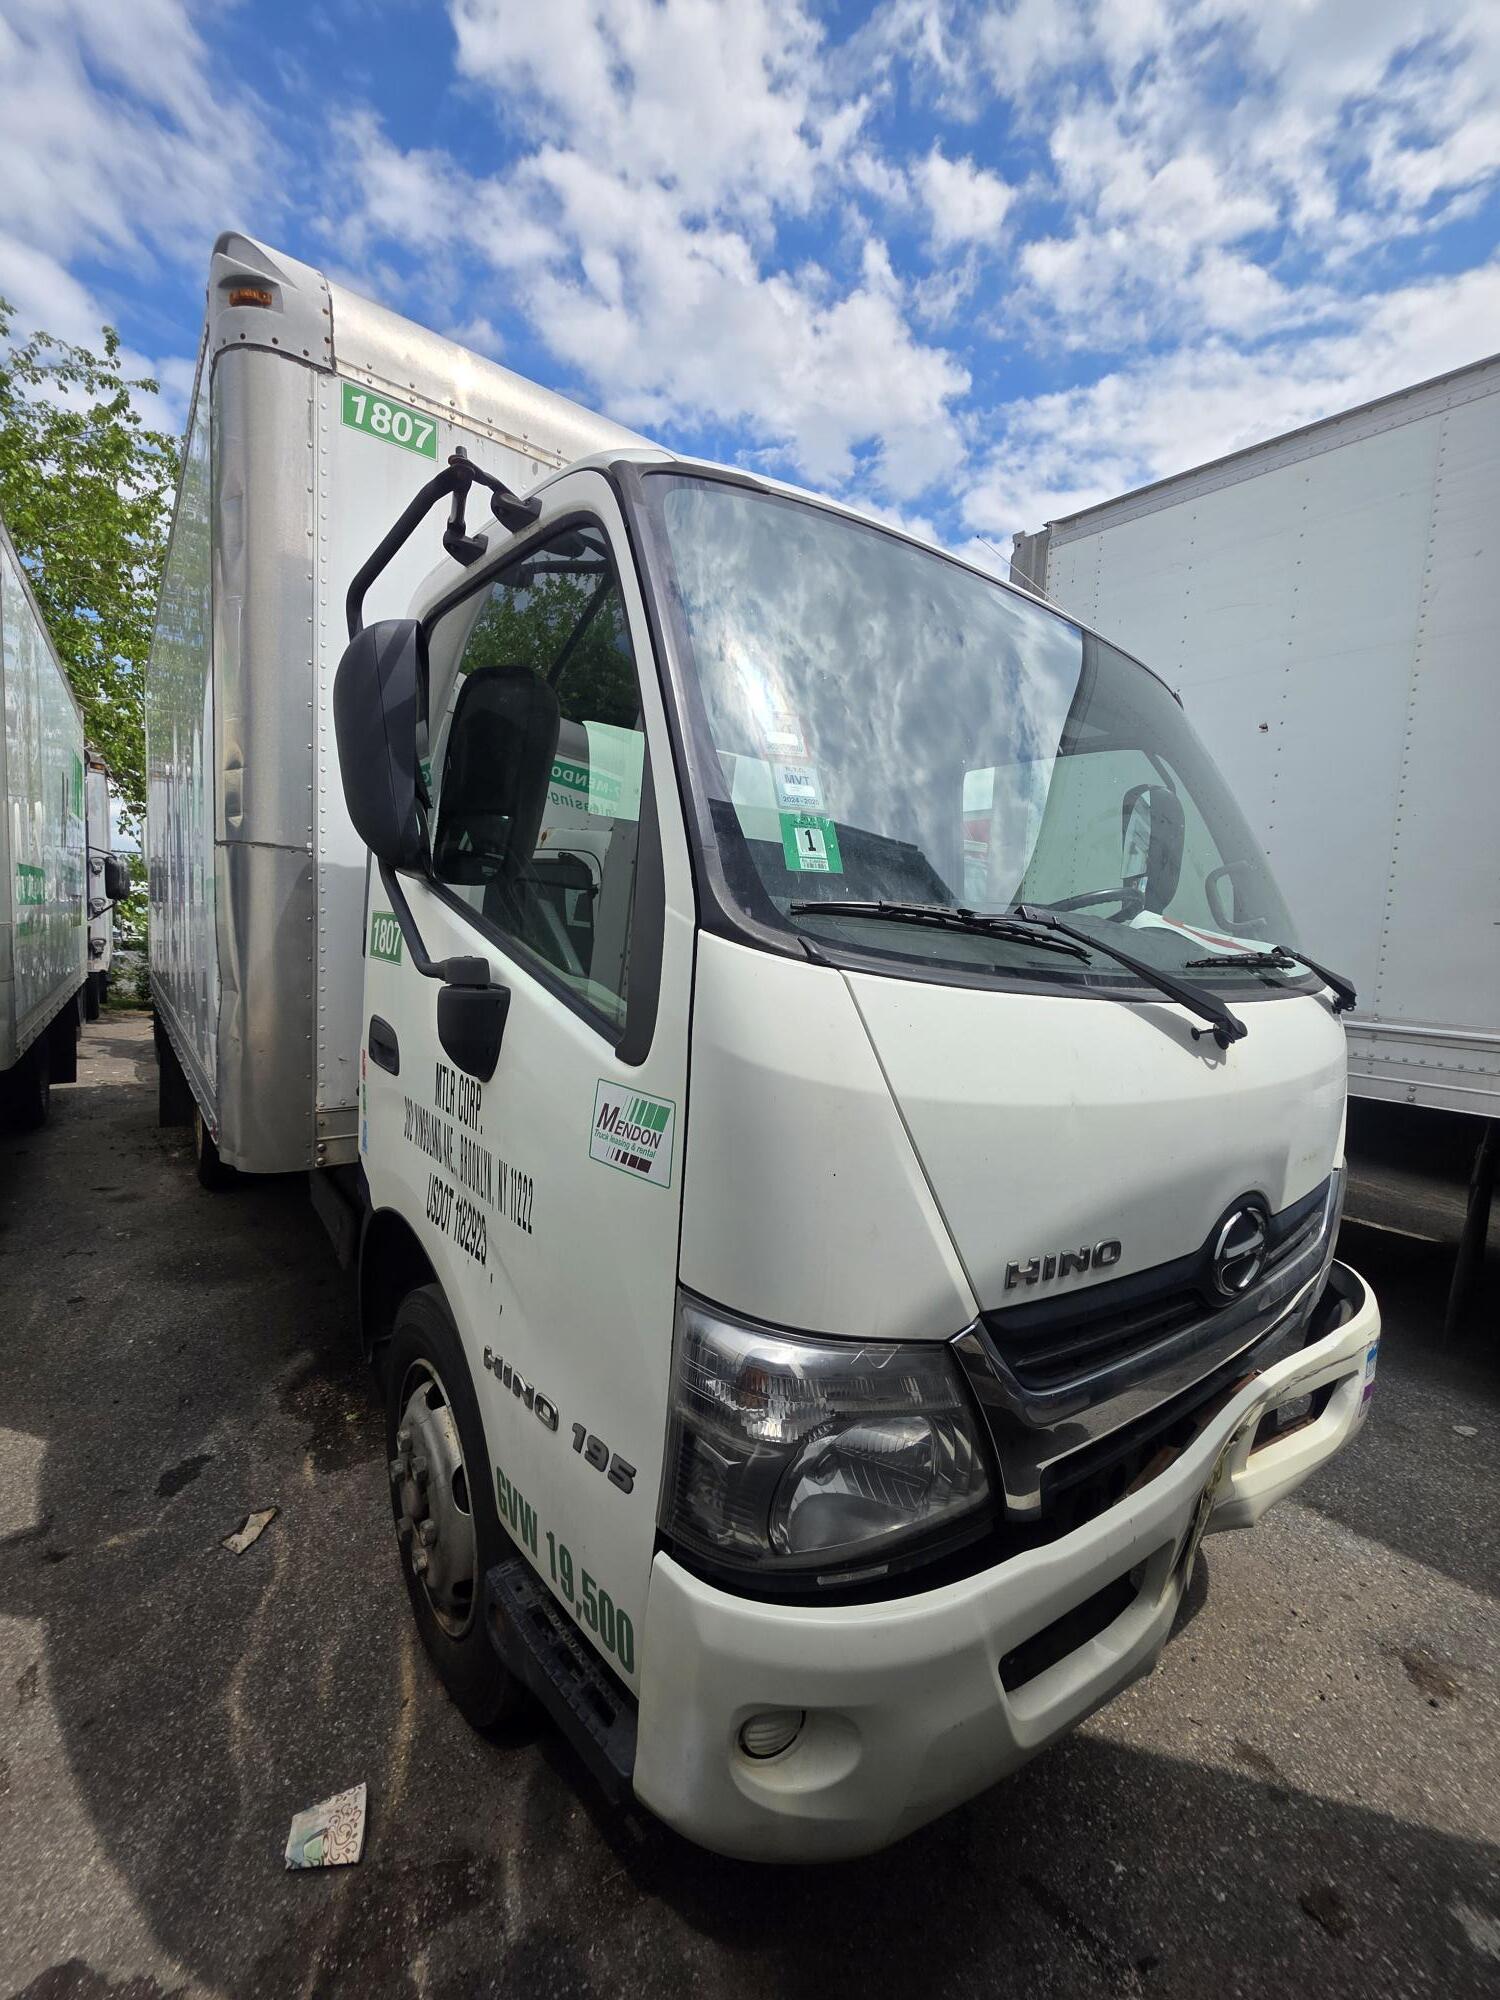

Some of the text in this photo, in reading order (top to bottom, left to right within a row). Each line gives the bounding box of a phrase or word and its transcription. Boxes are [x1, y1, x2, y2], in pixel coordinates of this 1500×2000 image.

[351, 394, 434, 449] 1807
[805, 829, 817, 851] 1
[373, 918, 401, 956] 1807
[434, 1062, 455, 1117] MTLR
[458, 1074, 483, 1135] CORP.
[426, 1172, 488, 1266] USDOT 1182923
[498, 1159, 508, 1216] NY
[510, 1167, 533, 1234] 11222
[1004, 1238, 1122, 1290] HINO
[484, 1344, 637, 1495] HINO 195
[496, 1465, 635, 1675] GVW 19,500
